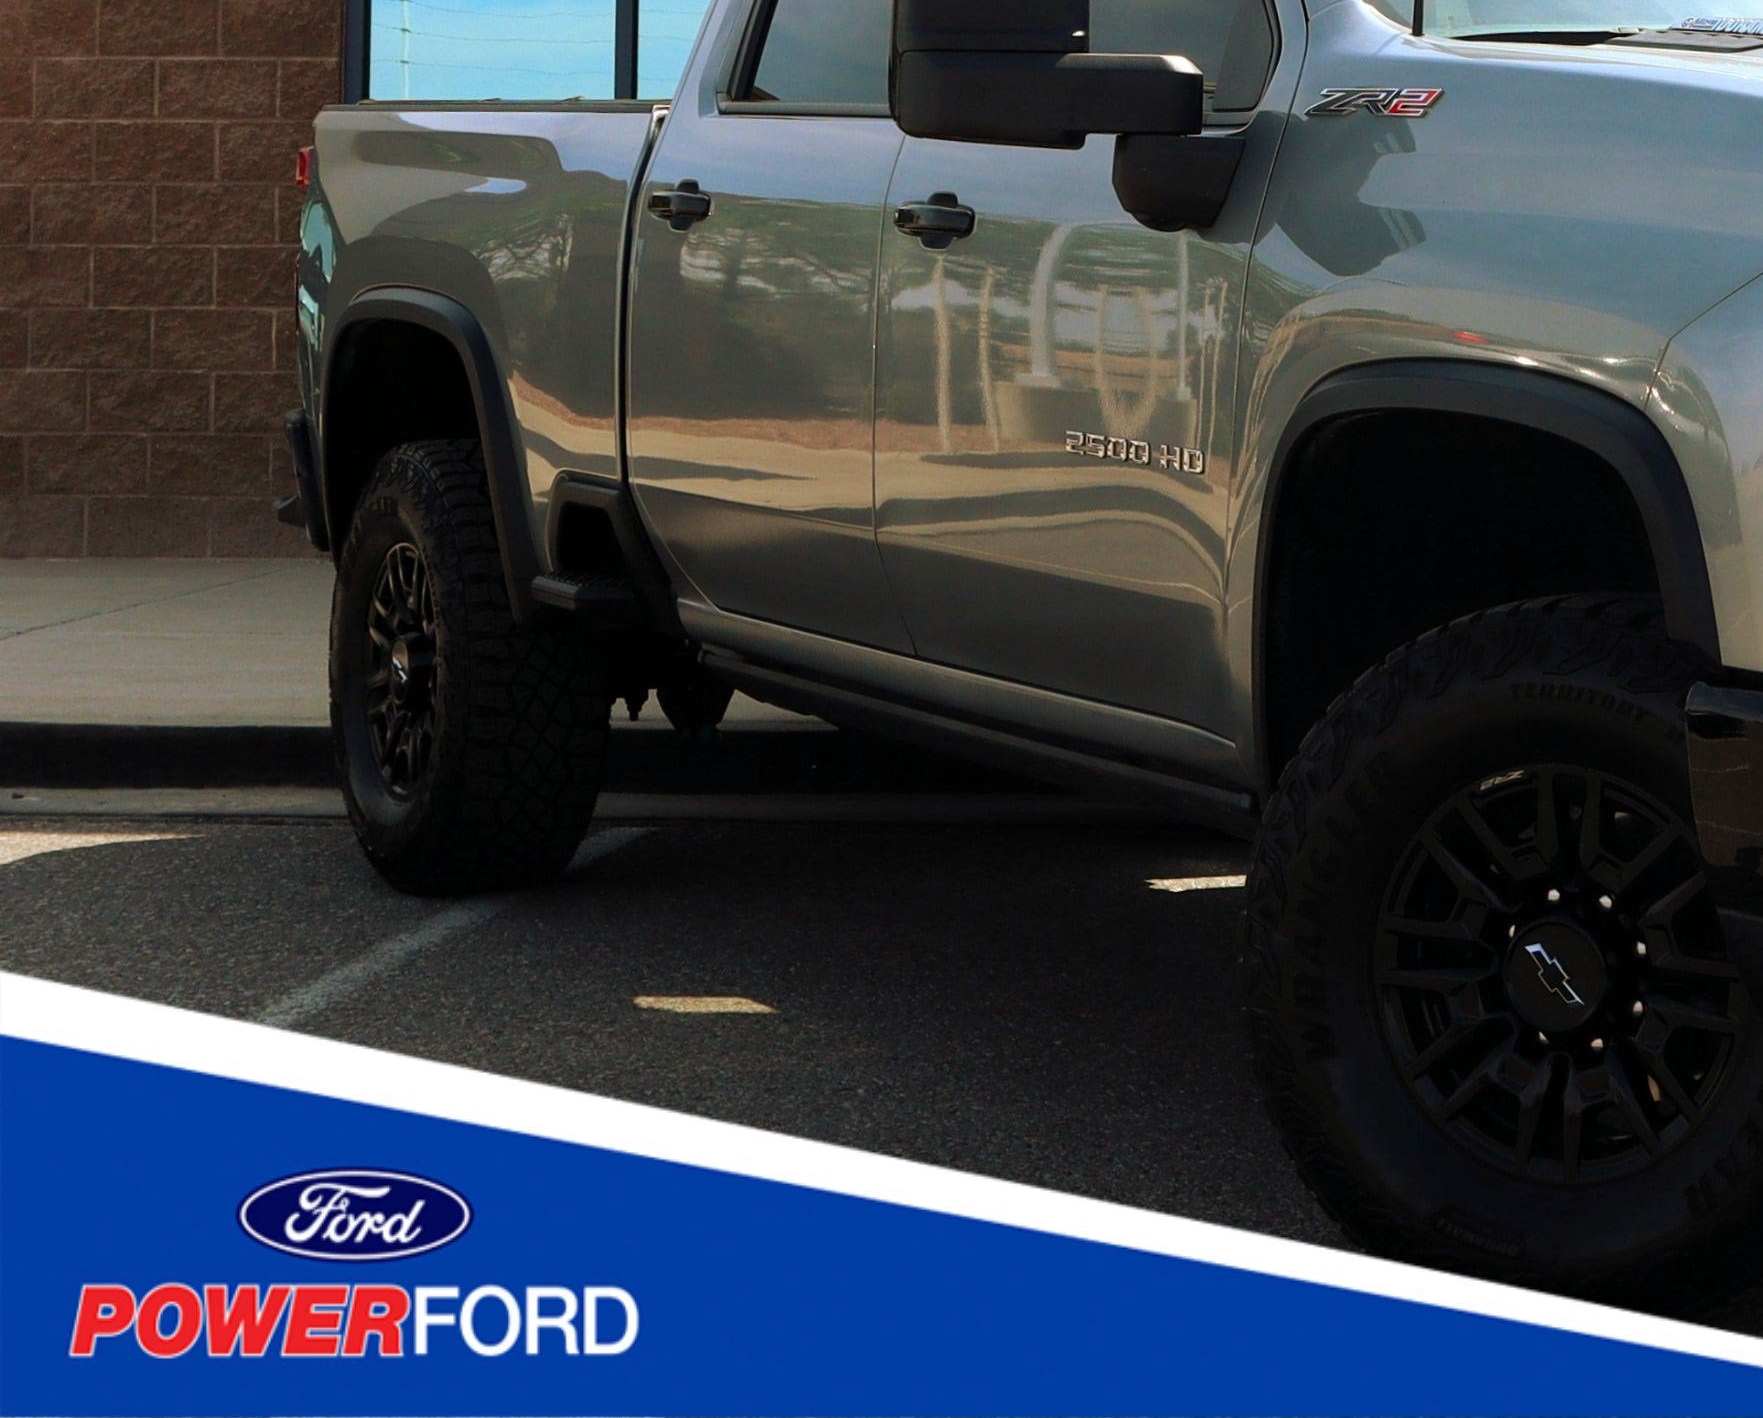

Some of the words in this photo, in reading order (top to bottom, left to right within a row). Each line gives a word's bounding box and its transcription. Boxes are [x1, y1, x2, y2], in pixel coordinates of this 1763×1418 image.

[1304, 87, 1443, 117] ZR2
[1065, 430, 1150, 465] 2500
[1160, 443, 1205, 474] HD
